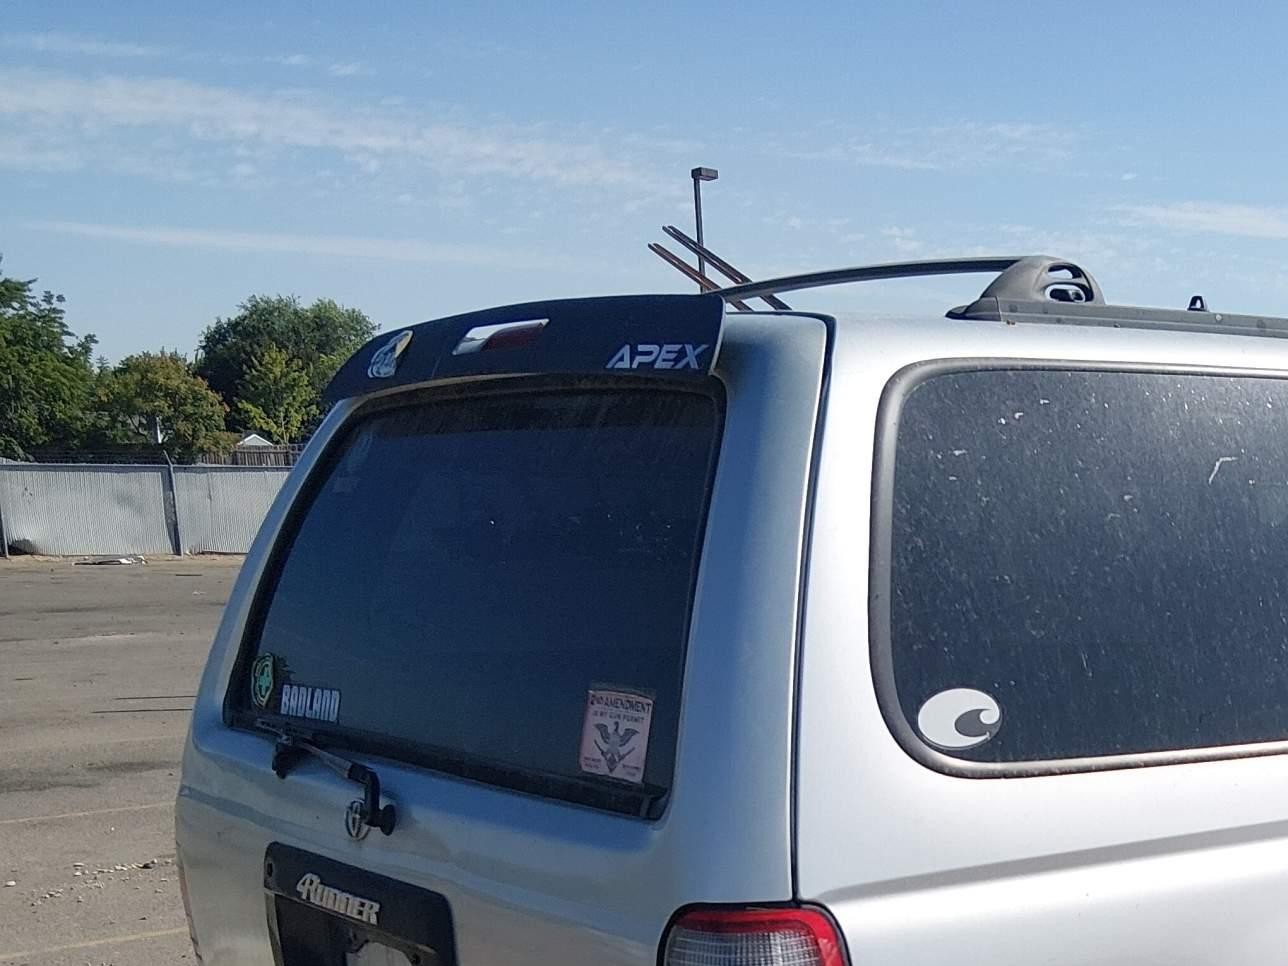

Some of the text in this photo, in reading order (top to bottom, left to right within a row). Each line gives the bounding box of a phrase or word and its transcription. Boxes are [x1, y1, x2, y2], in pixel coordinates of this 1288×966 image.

[605, 343, 711, 370] APEX
[280, 684, 341, 722] BADLAND
[604, 696, 652, 713] AMENDMENT
